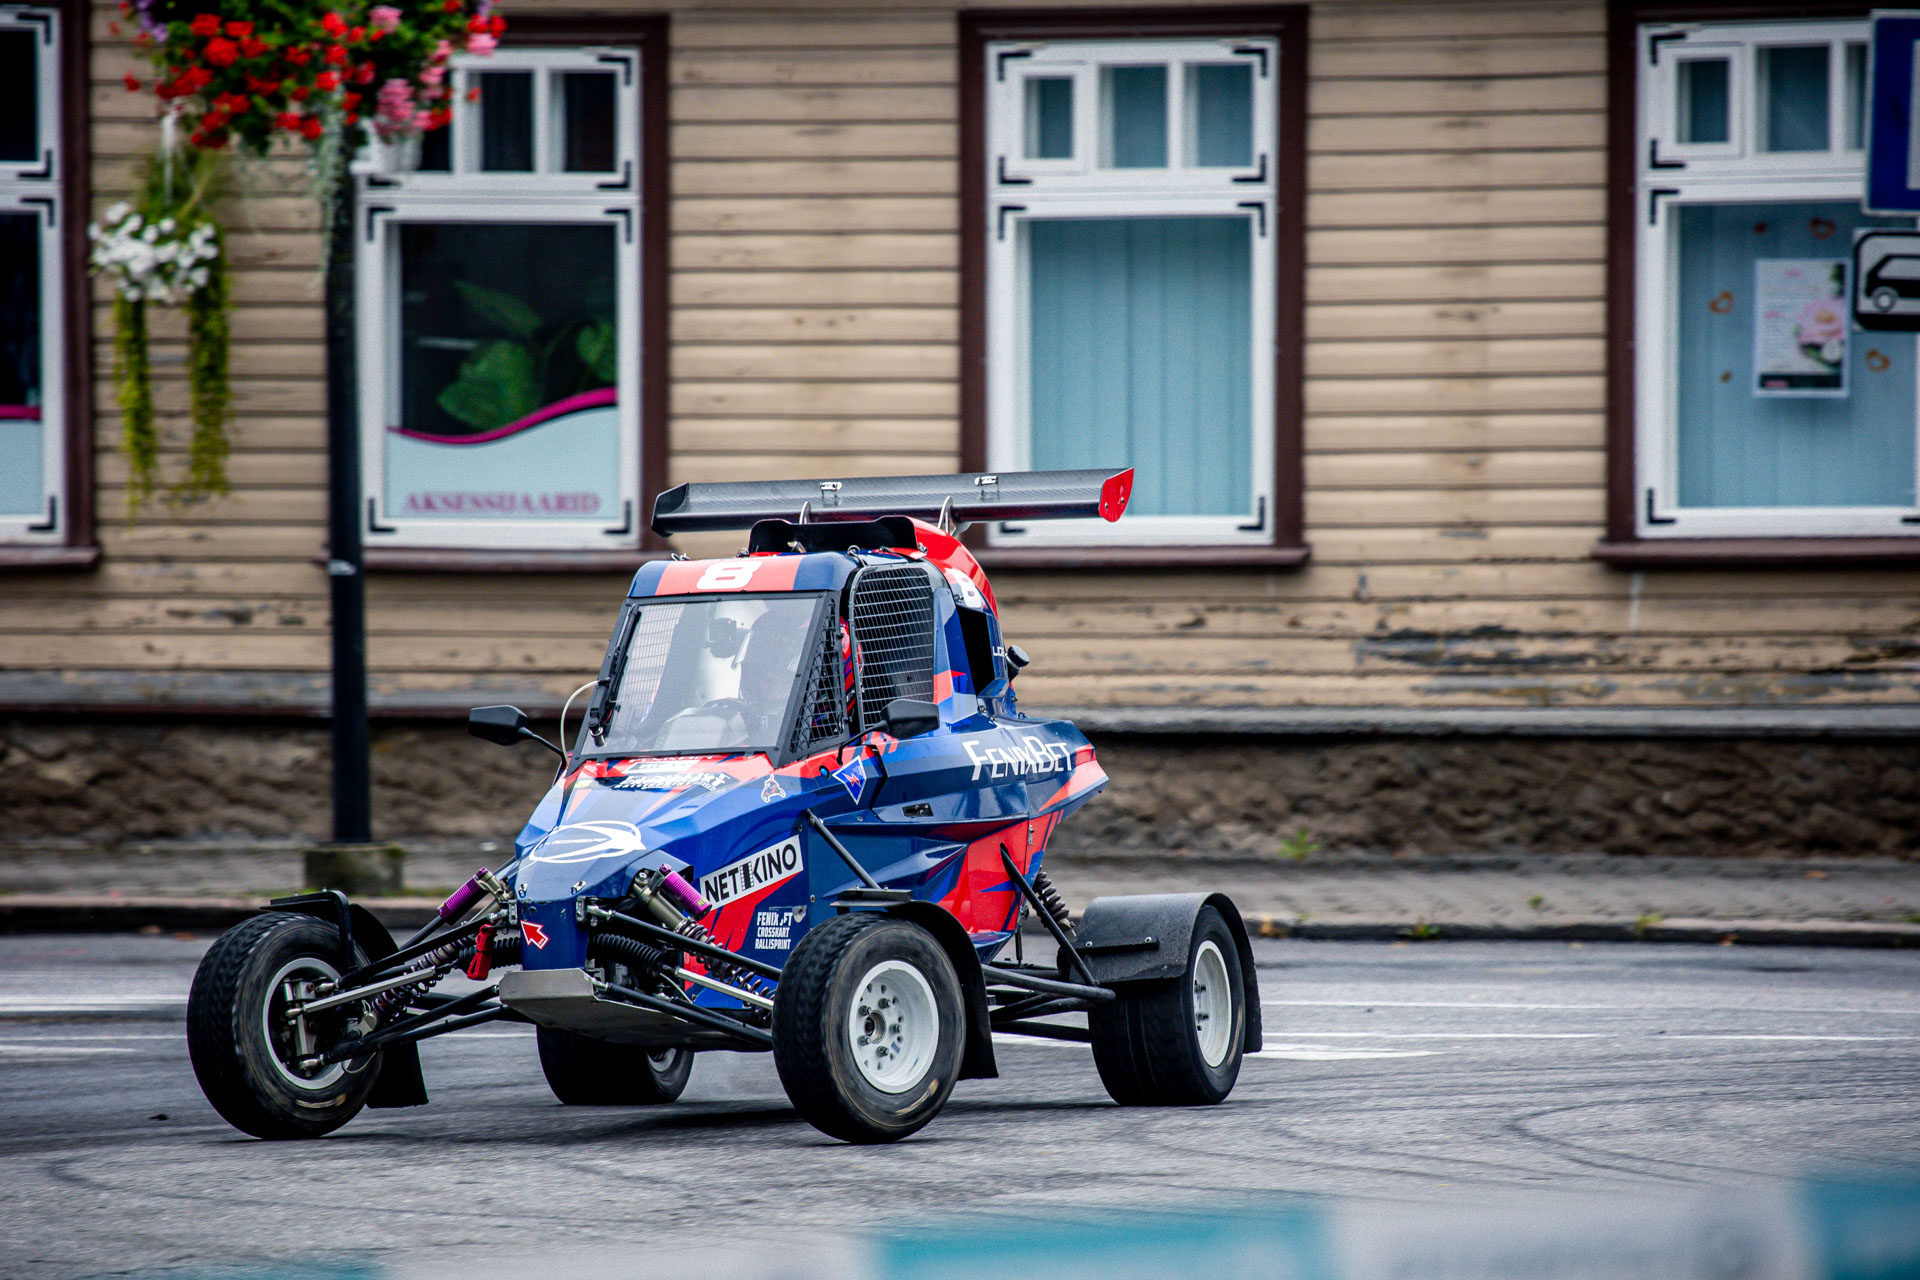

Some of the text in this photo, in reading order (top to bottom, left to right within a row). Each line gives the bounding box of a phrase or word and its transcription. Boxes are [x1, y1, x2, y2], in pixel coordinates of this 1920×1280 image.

[696, 560, 759, 590] 8
[757, 926, 790, 938] CROSSKART
[754, 938, 792, 950] RALLISPRINT
